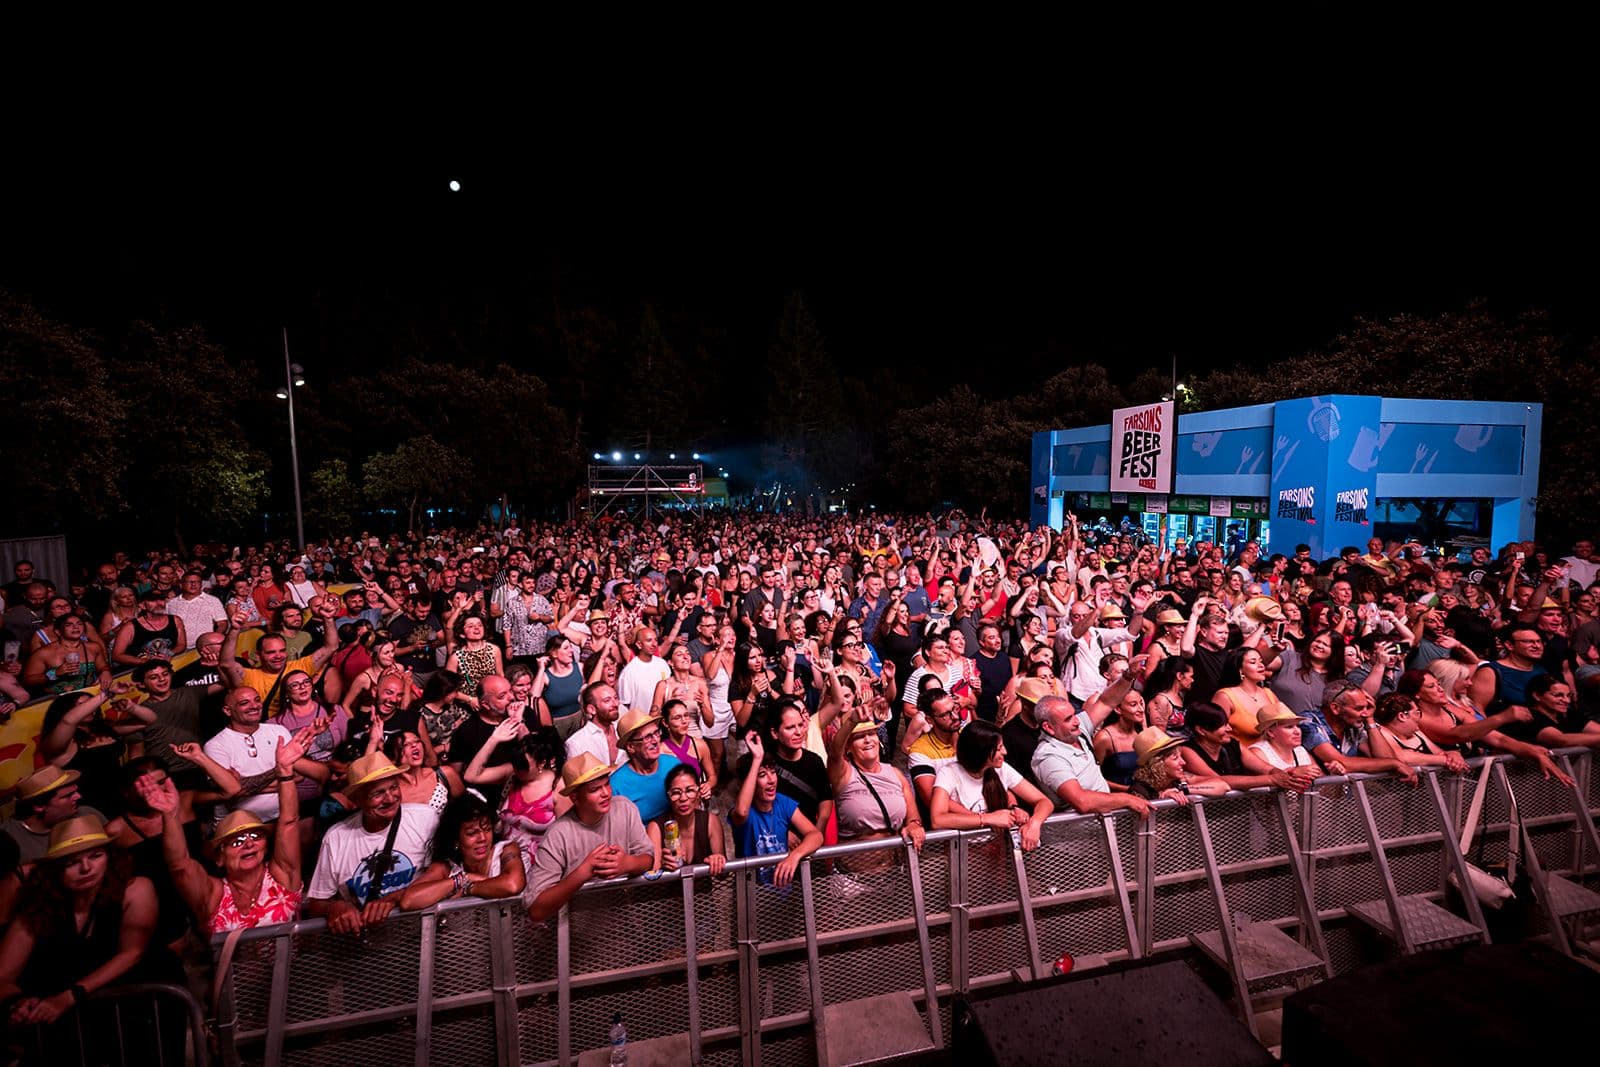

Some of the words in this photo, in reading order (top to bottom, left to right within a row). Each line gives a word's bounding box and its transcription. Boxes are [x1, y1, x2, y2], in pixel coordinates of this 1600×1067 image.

[1124, 405, 1162, 432] FARSONS
[1121, 430, 1161, 459] BEER
[1120, 449, 1162, 478] FEST
[1279, 500, 1298, 511] BEER
[1280, 486, 1315, 508] FARSONS
[1336, 502, 1354, 514] BEER
[1337, 488, 1369, 510] FARSONS
[1278, 507, 1315, 521] FESTIVAL
[1335, 508, 1369, 524] FESTIVAL
